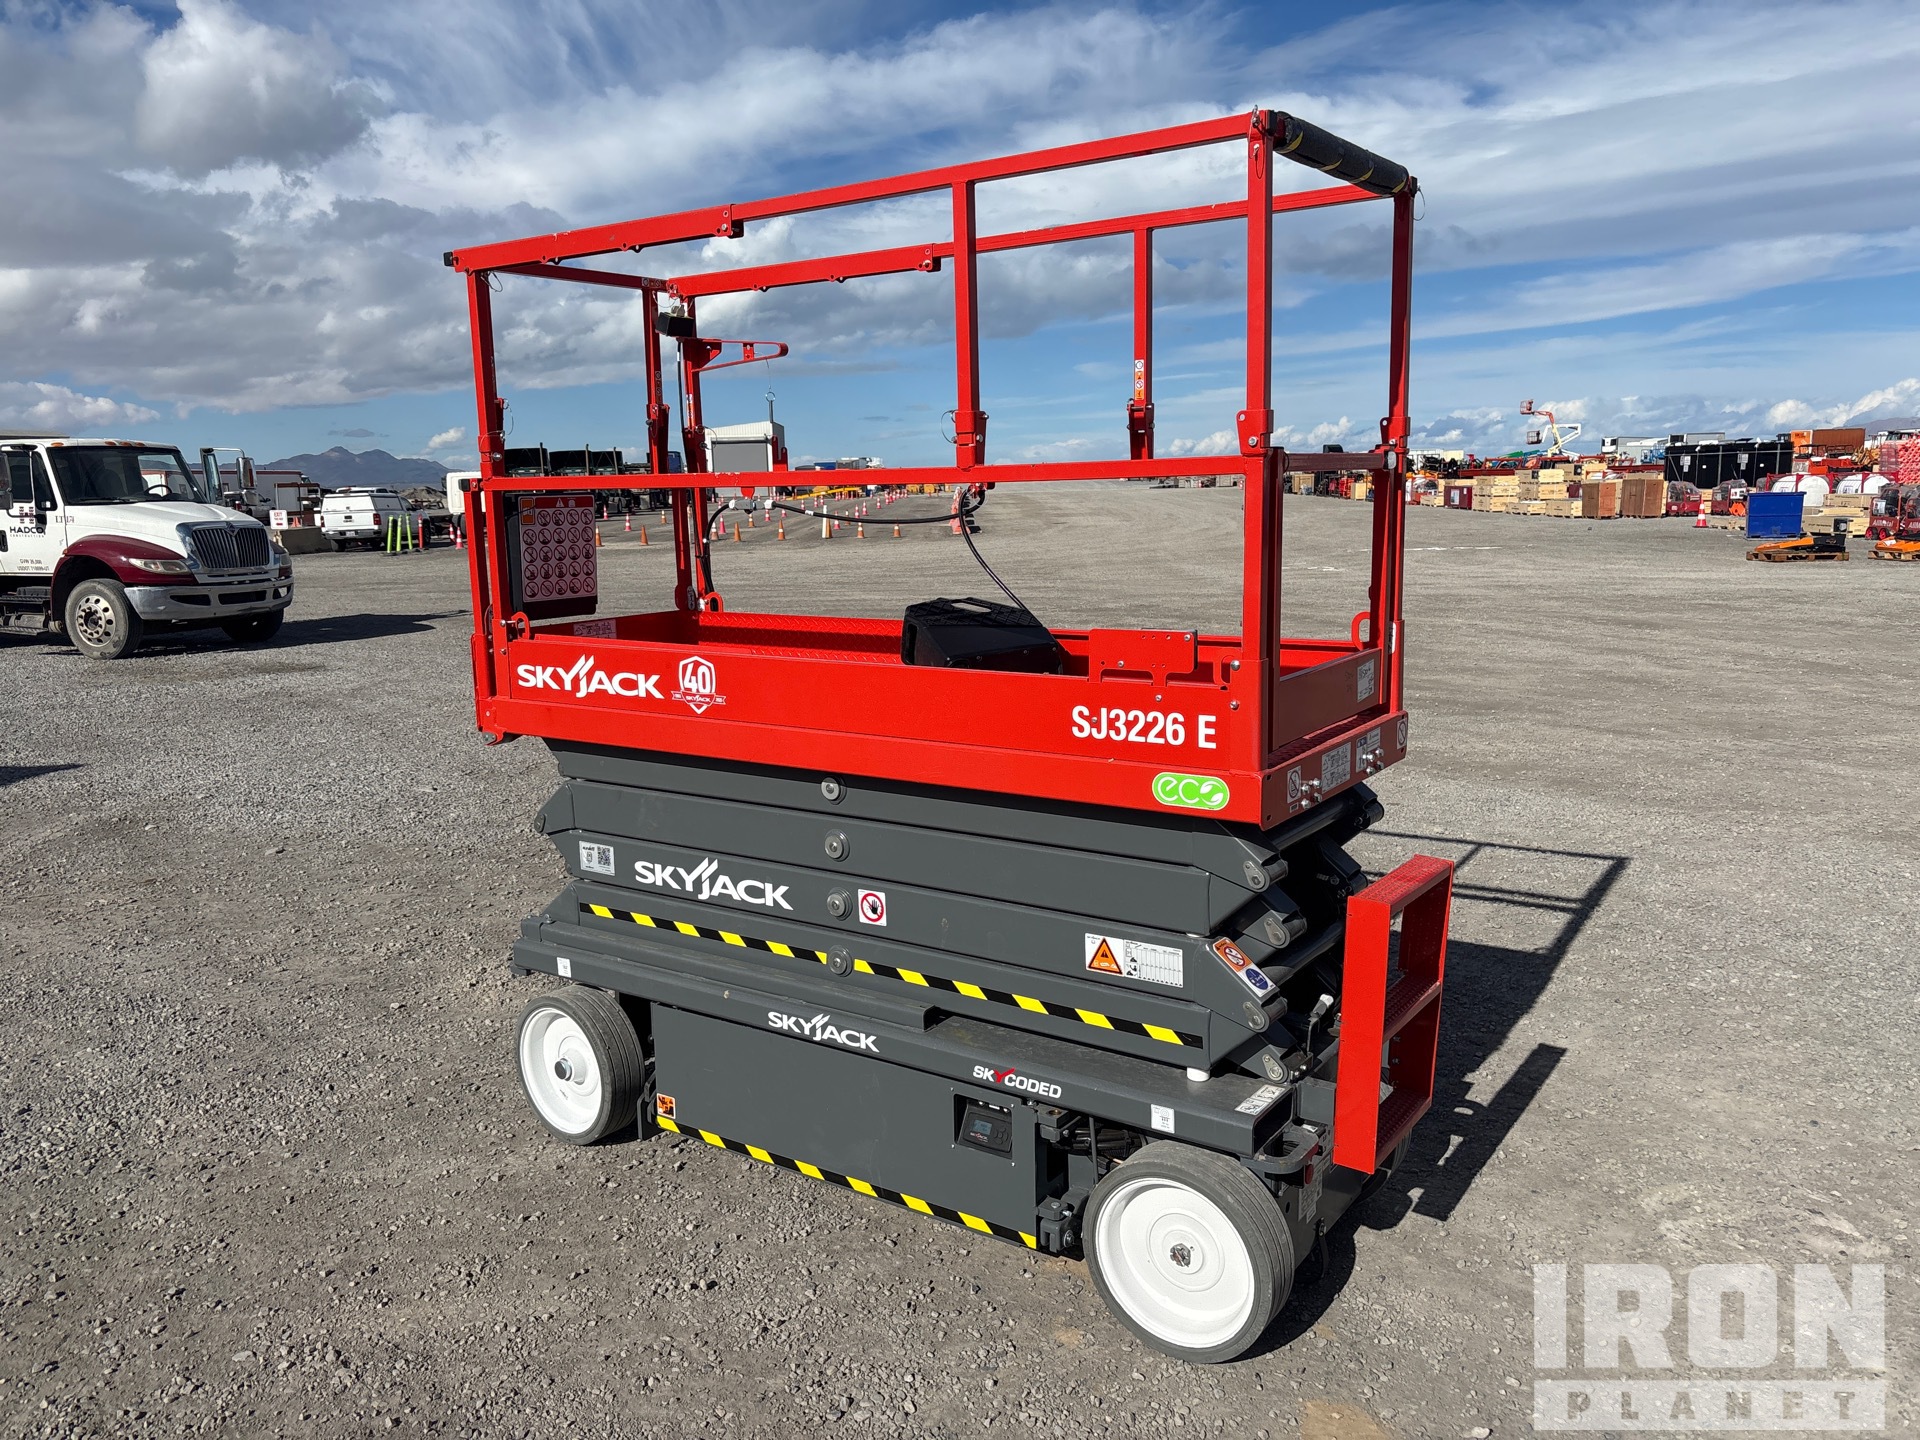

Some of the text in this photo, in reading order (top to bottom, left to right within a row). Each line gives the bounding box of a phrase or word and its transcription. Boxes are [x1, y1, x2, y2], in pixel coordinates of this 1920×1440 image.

[9, 526, 44, 534] HADCO
[516, 653, 665, 699] SKYJACK
[683, 662, 711, 693] 40
[1071, 705, 1217, 749] SJ3226 E
[634, 856, 794, 911] SKYJACK
[767, 1012, 880, 1053] SKYJACK
[972, 1065, 1062, 1099] SKYCODED
